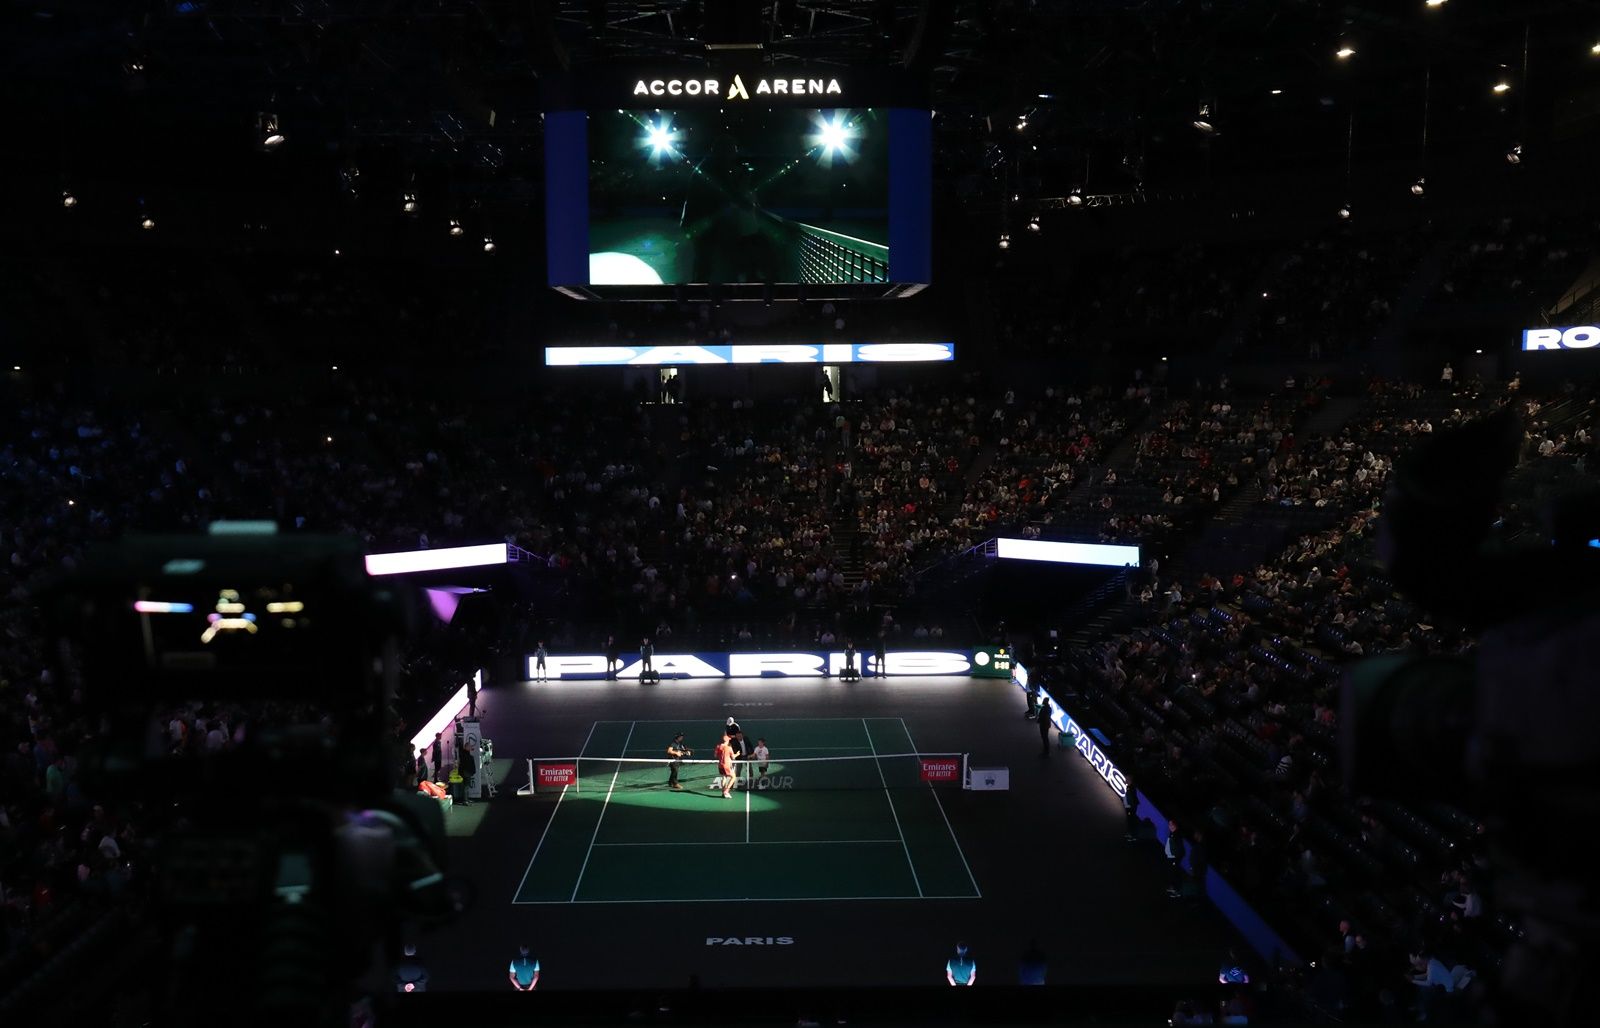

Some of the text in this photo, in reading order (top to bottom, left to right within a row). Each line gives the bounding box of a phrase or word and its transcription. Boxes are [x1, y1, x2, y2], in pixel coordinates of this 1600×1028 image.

[633, 79, 719, 95] ACCOR
[756, 78, 842, 94] ARENA
[546, 343, 953, 365] PARIS
[529, 651, 971, 678] PARIS
[1065, 719, 1128, 797] PARIS
[540, 767, 573, 775] Emirates
[923, 763, 956, 771] Emirates
[706, 936, 794, 945] PARIS
